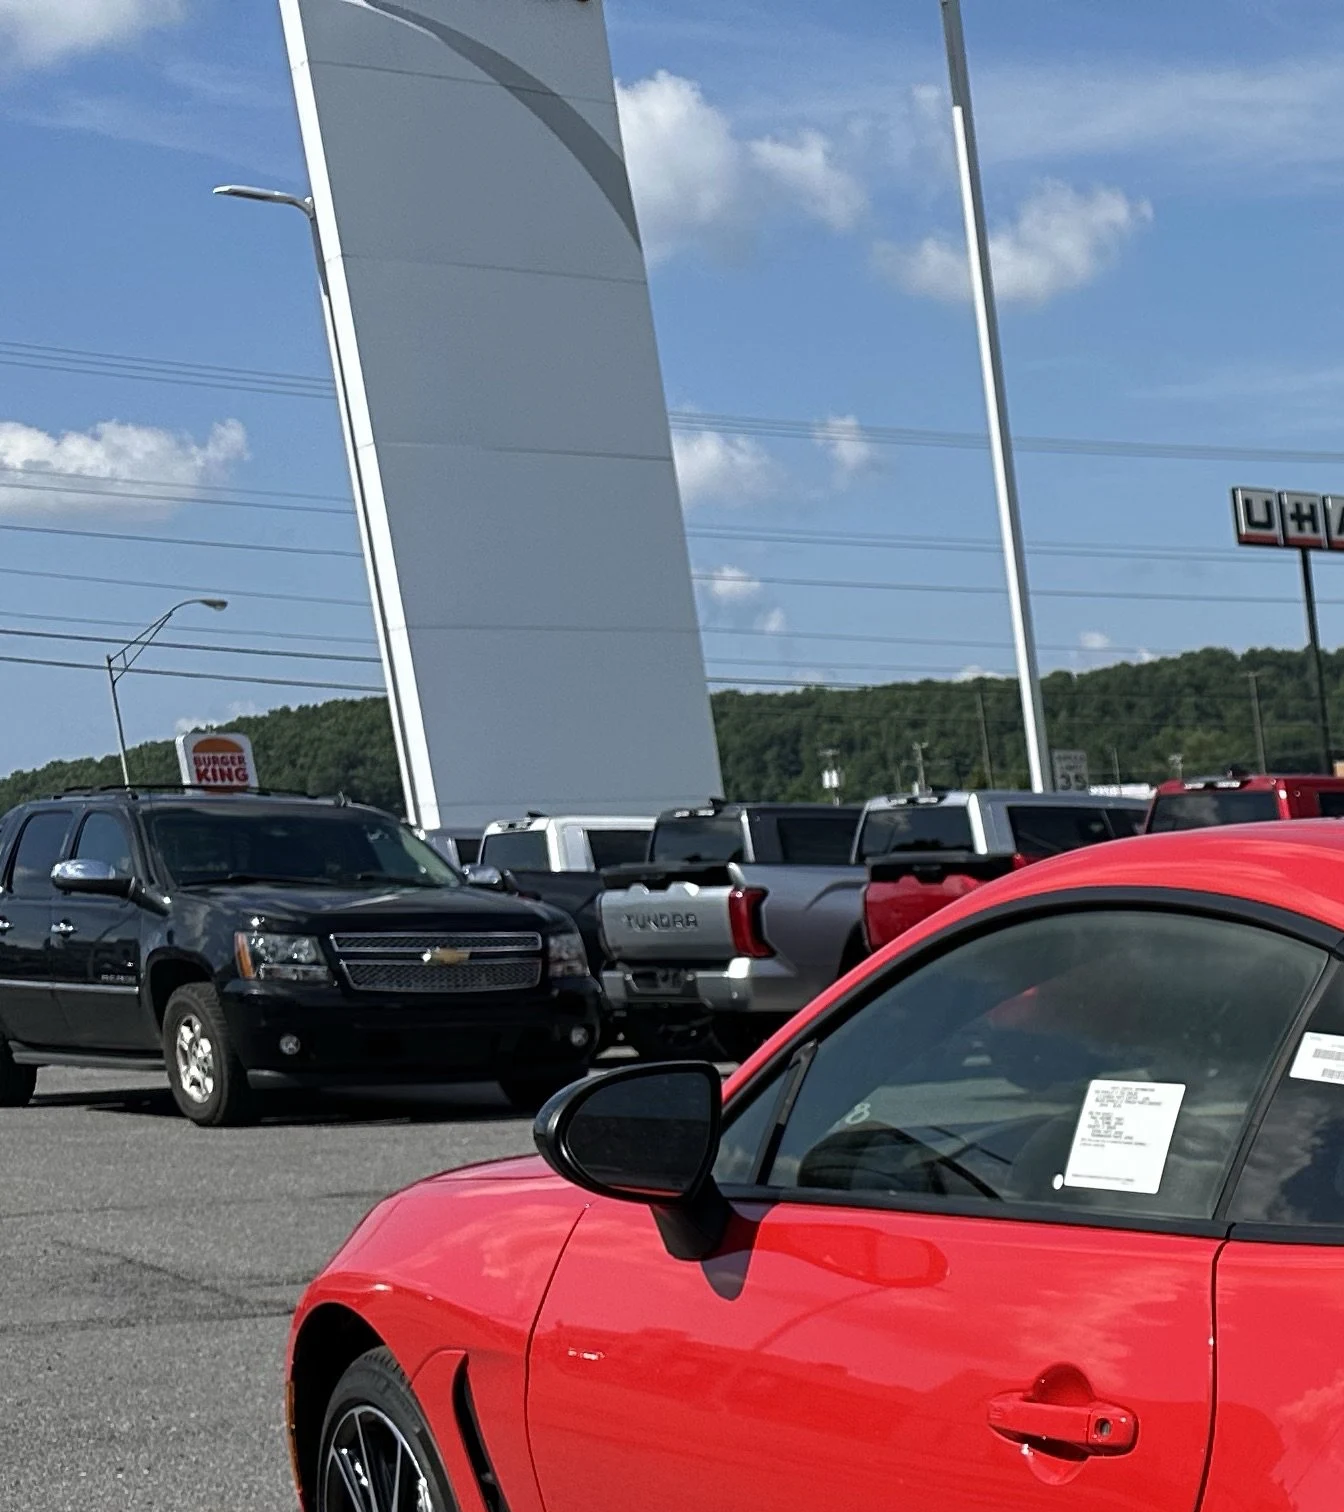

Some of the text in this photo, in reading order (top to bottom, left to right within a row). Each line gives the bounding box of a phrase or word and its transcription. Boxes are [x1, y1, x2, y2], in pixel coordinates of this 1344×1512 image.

[193, 755, 246, 767] BURGER
[195, 767, 249, 783] KING
[622, 912, 699, 932] TUNDRA
